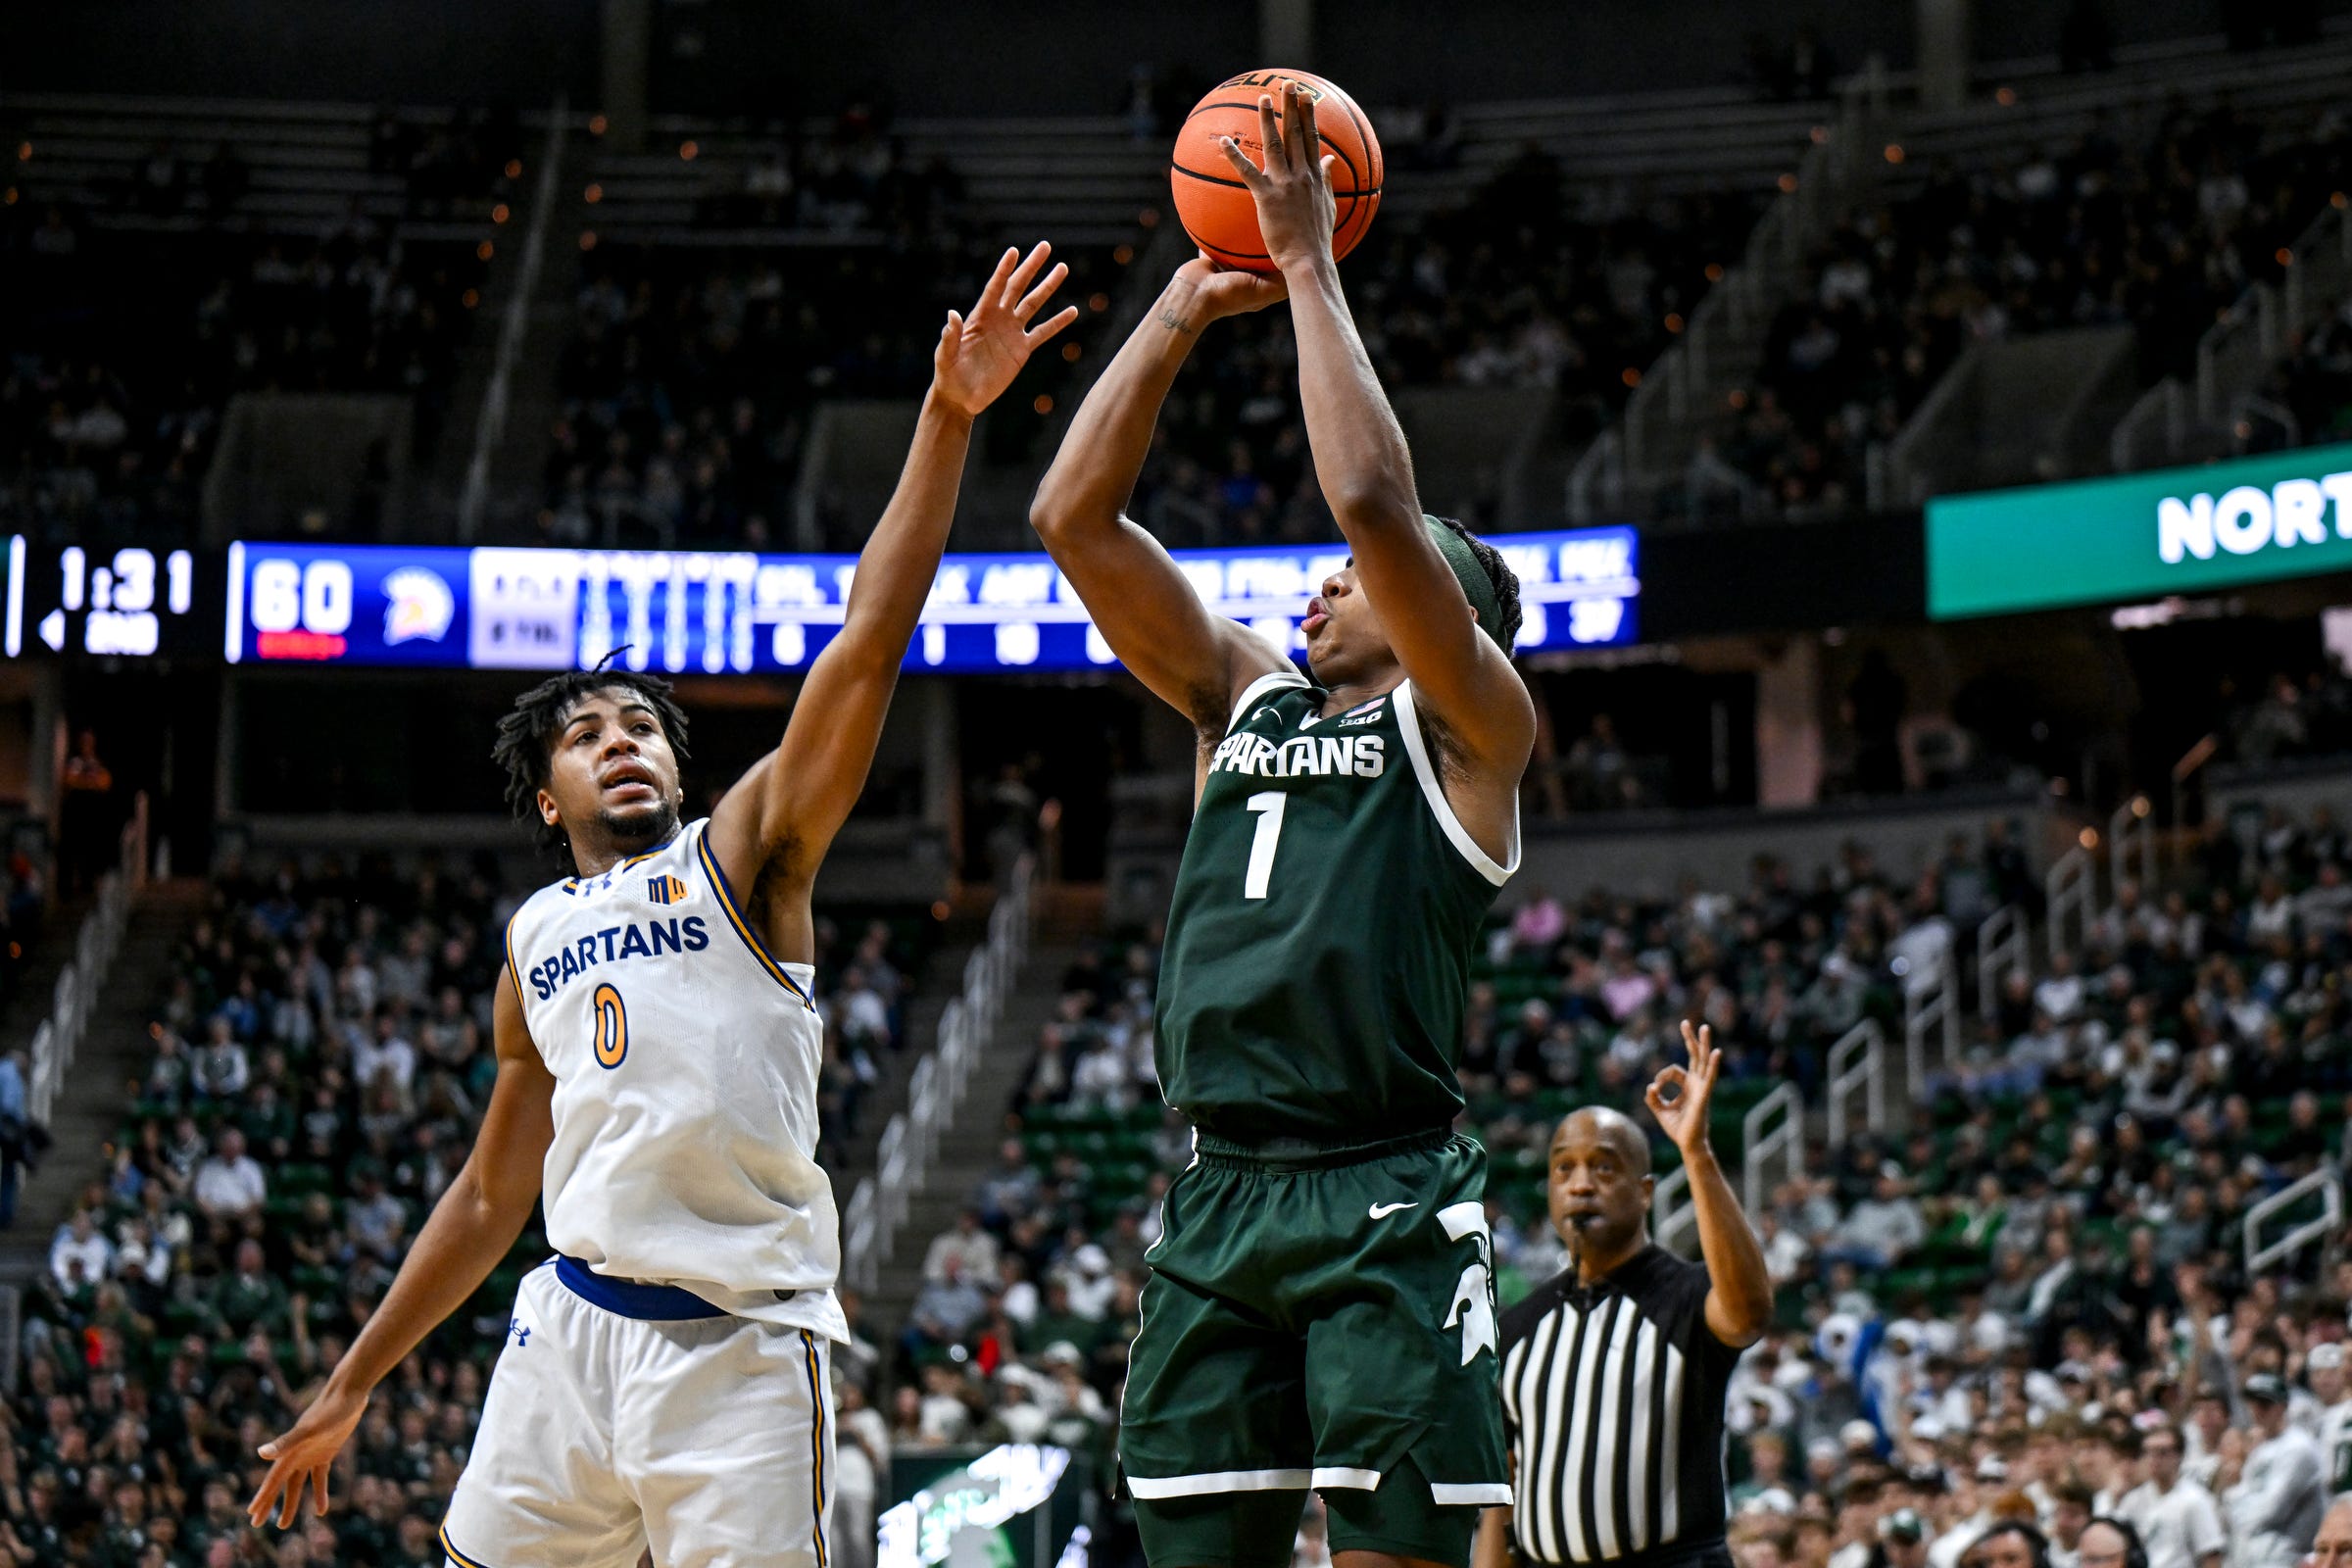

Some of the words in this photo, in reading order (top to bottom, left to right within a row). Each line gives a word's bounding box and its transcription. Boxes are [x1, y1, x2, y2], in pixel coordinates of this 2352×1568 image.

[2158, 471, 2352, 564] NORT
[61, 546, 192, 614] 1:31
[251, 558, 353, 634] 60
[1245, 791, 1287, 900] 1
[529, 915, 710, 1001] SPARTANS
[593, 982, 628, 1069] 0
